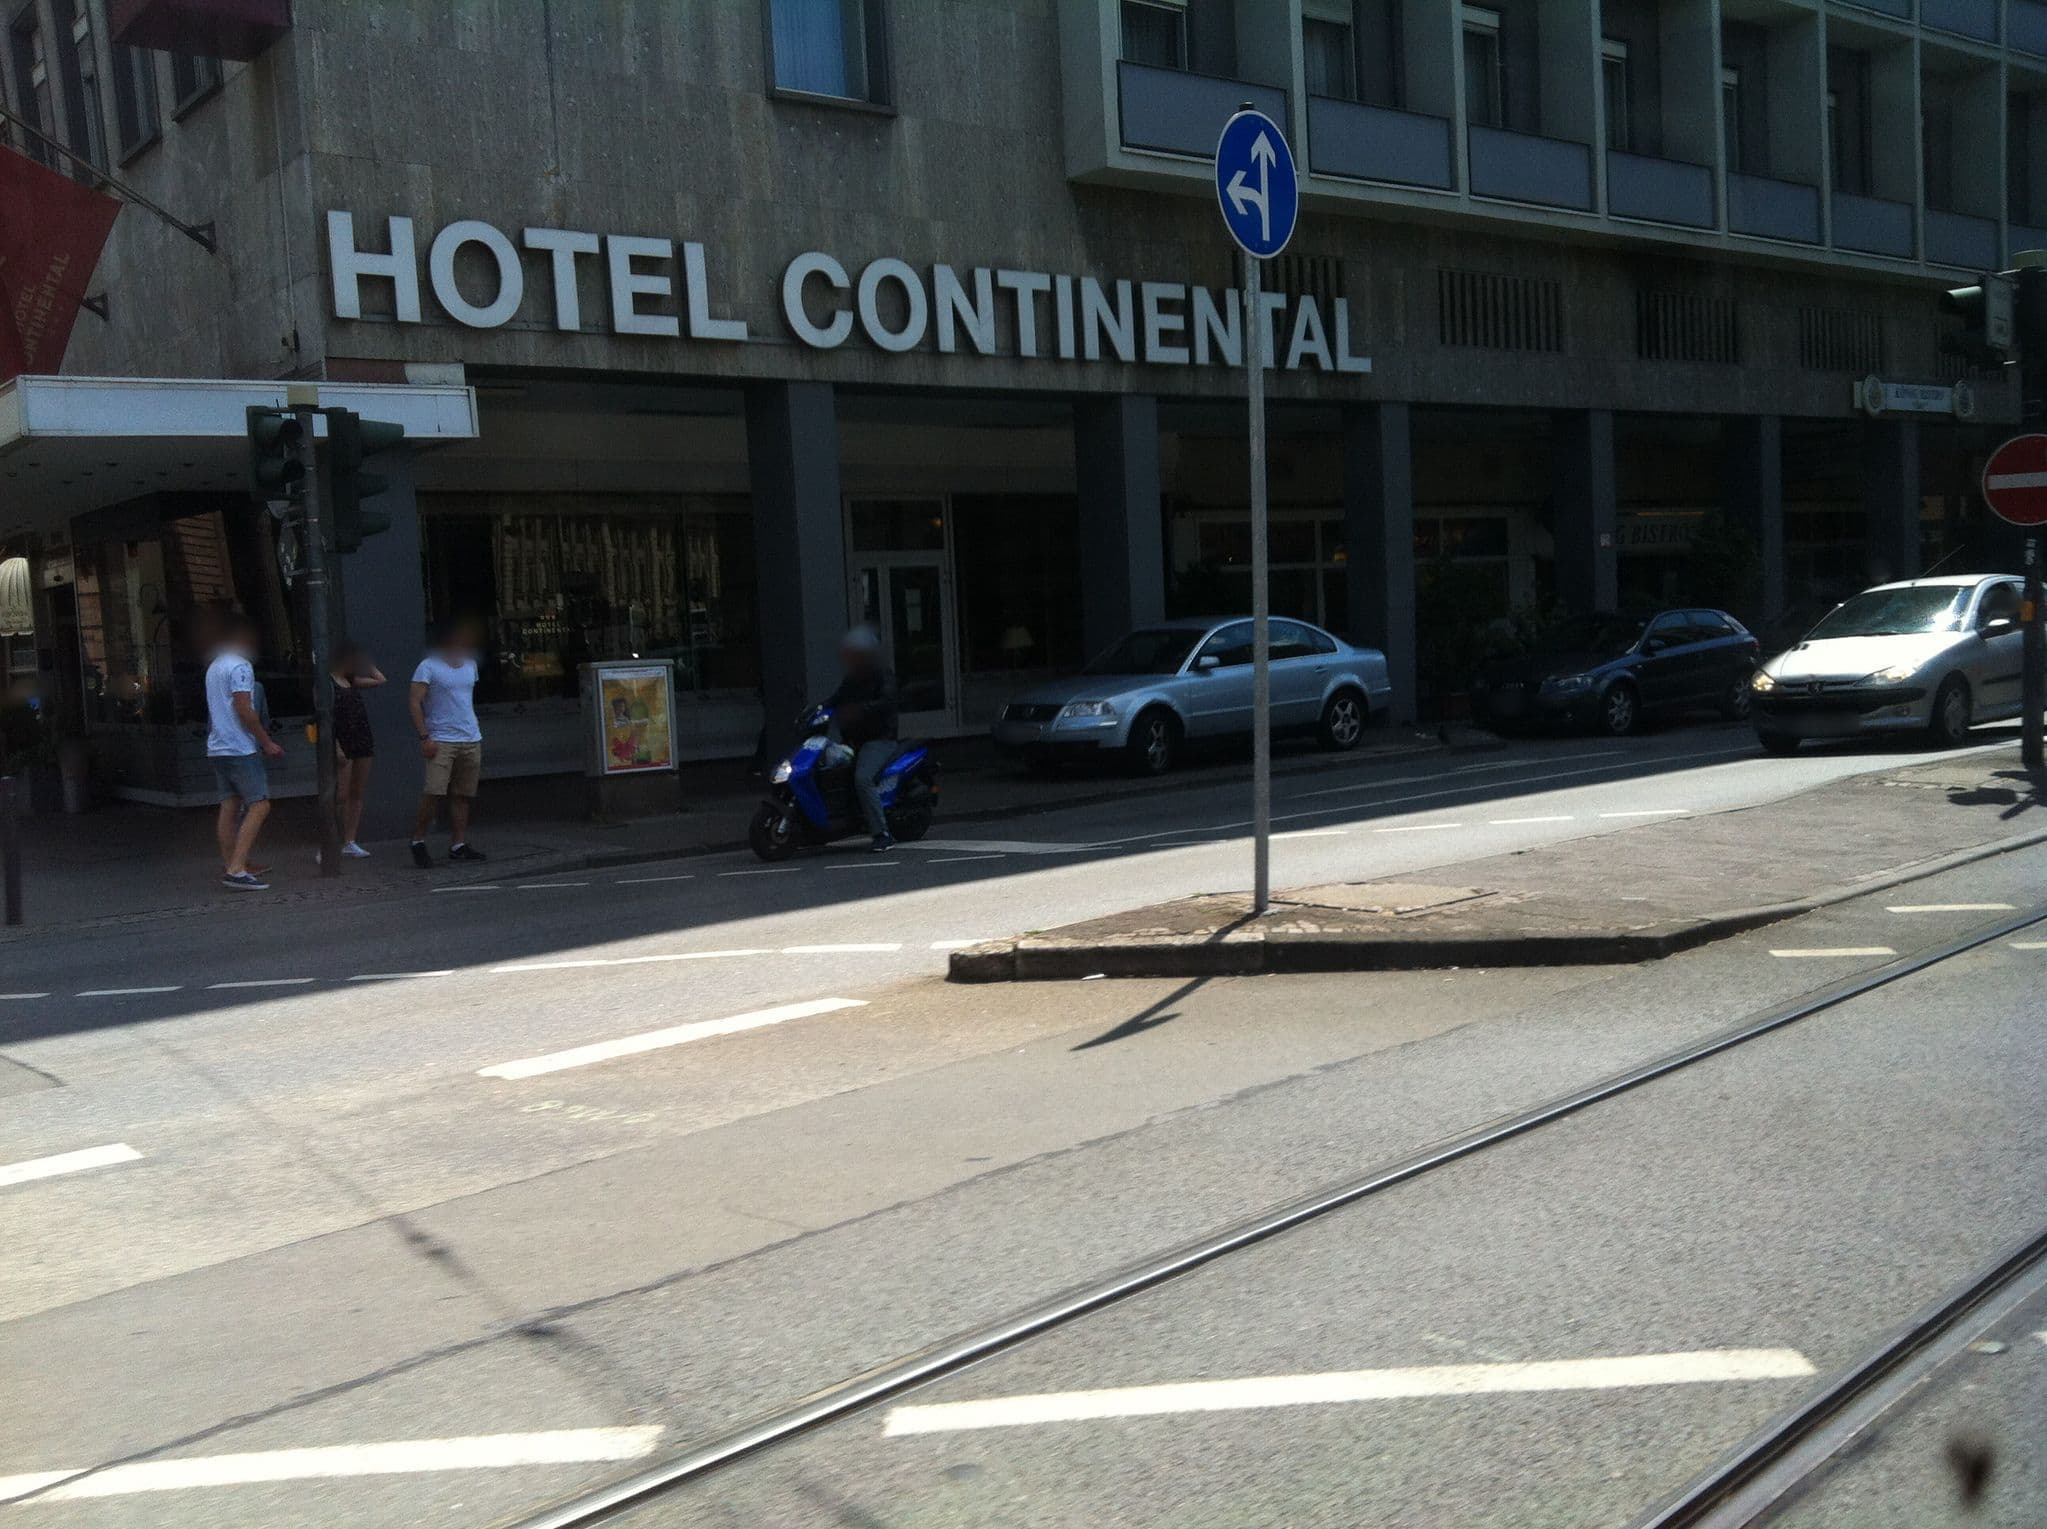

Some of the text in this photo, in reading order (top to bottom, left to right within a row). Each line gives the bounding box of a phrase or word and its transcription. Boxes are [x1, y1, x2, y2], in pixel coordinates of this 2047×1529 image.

[23, 253, 70, 366] ONTINENTAL
[327, 210, 1373, 373] HOTEL CONTINENTAL
